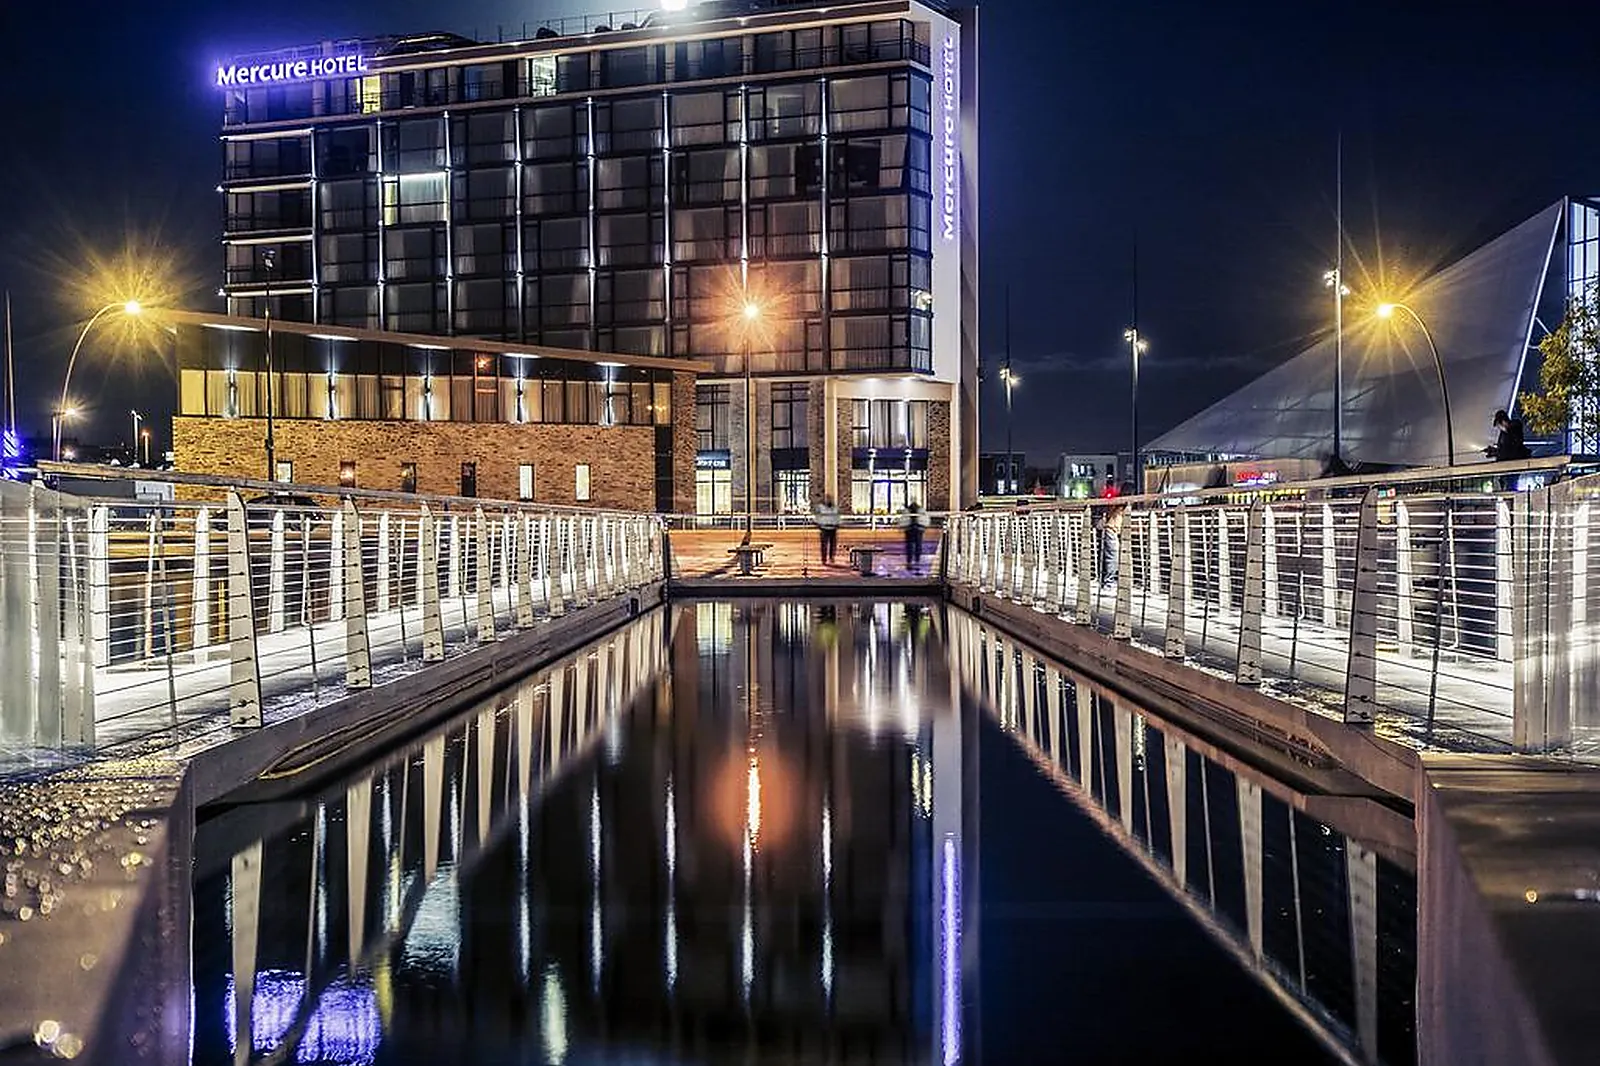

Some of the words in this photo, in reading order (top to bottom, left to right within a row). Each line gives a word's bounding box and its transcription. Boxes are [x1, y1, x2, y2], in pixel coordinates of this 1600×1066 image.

[216, 61, 308, 86] Mercure
[311, 55, 368, 75] HOTEL
[943, 36, 955, 110] HOTEL
[943, 115, 955, 240] Mercure
